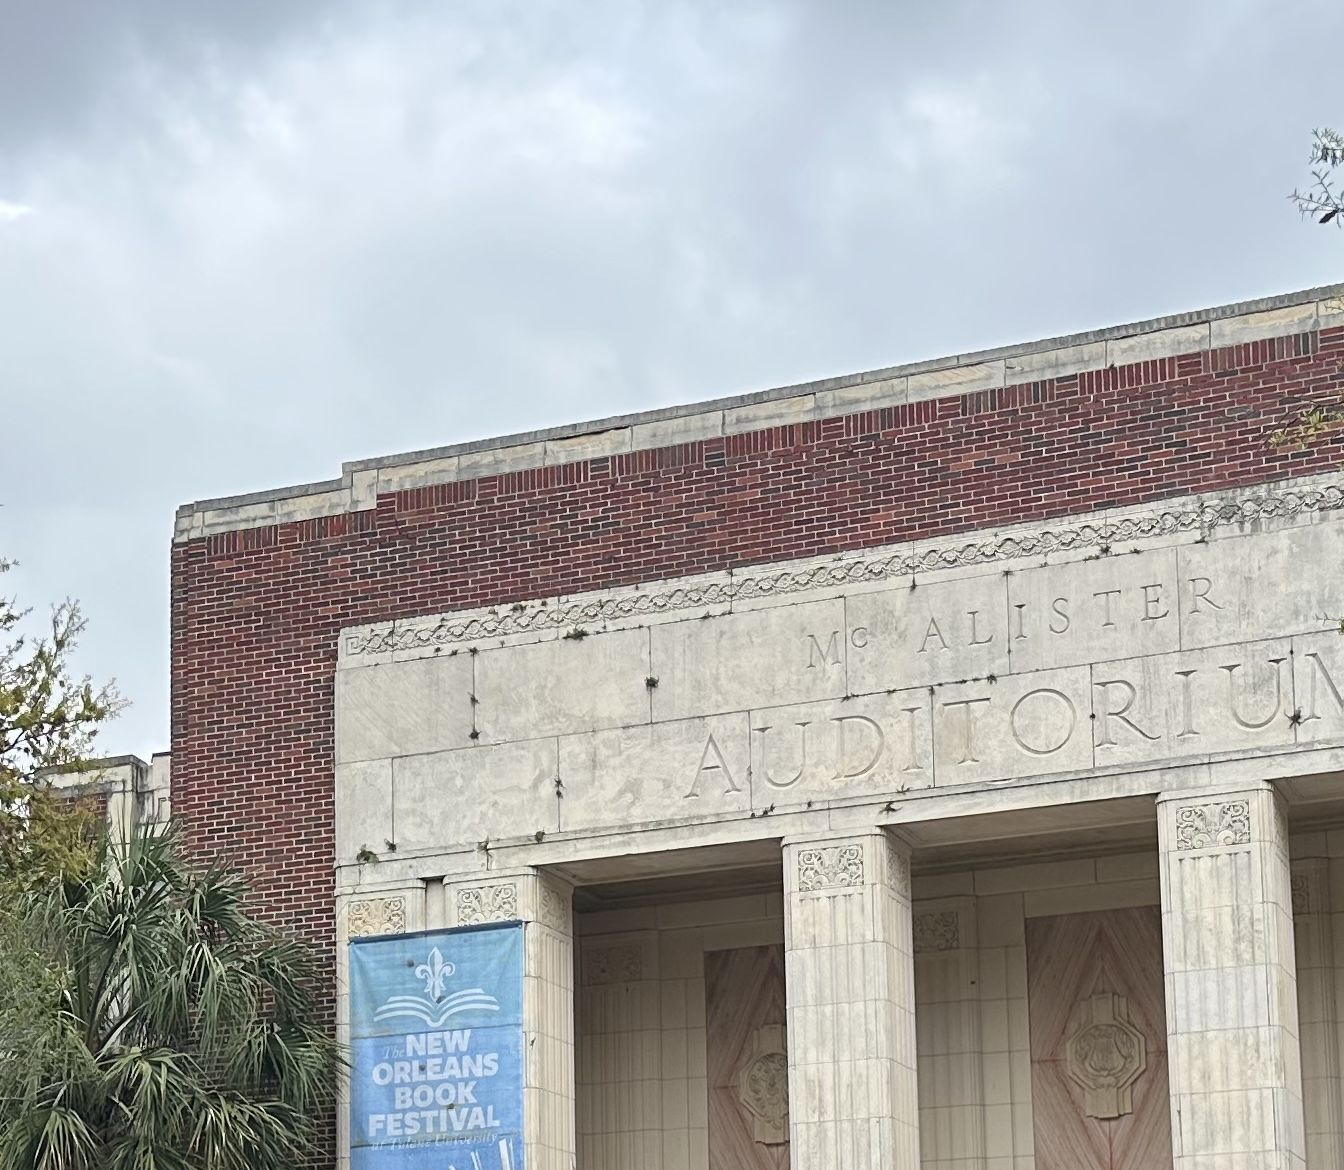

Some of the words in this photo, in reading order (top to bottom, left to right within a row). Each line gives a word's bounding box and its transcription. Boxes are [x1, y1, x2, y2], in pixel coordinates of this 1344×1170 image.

[916, 575, 1225, 654] ALISTER
[406, 1028, 472, 1057] NEW
[372, 1052, 499, 1086] ORLEANS
[394, 1080, 478, 1110] BOOK
[368, 1104, 501, 1137] FESTIVAL
